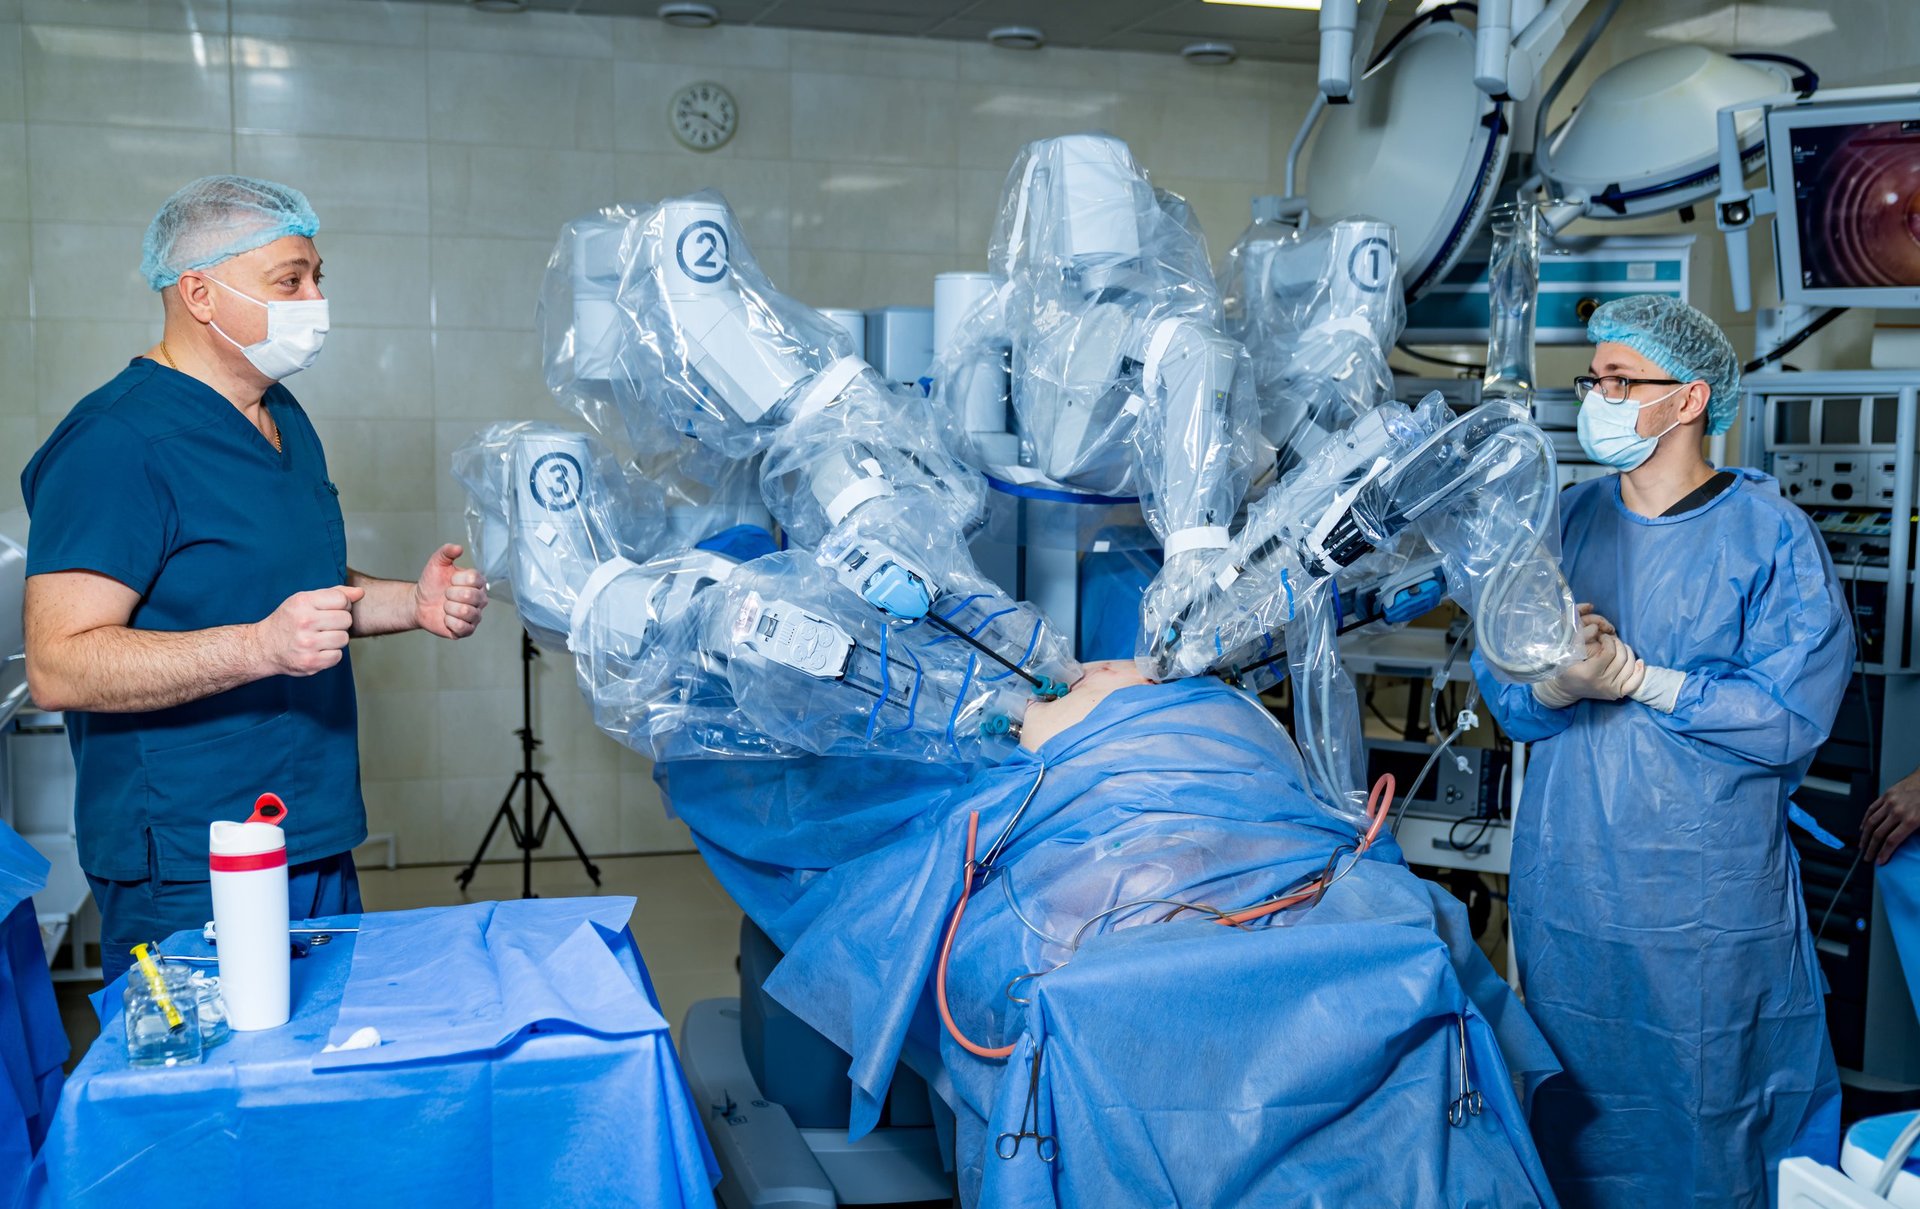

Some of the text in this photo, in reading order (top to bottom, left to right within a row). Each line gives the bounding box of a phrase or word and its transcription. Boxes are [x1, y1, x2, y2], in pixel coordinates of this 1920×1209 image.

[695, 232, 717, 268] 2
[1369, 249, 1379, 281] 1
[548, 464, 569, 498] 3
